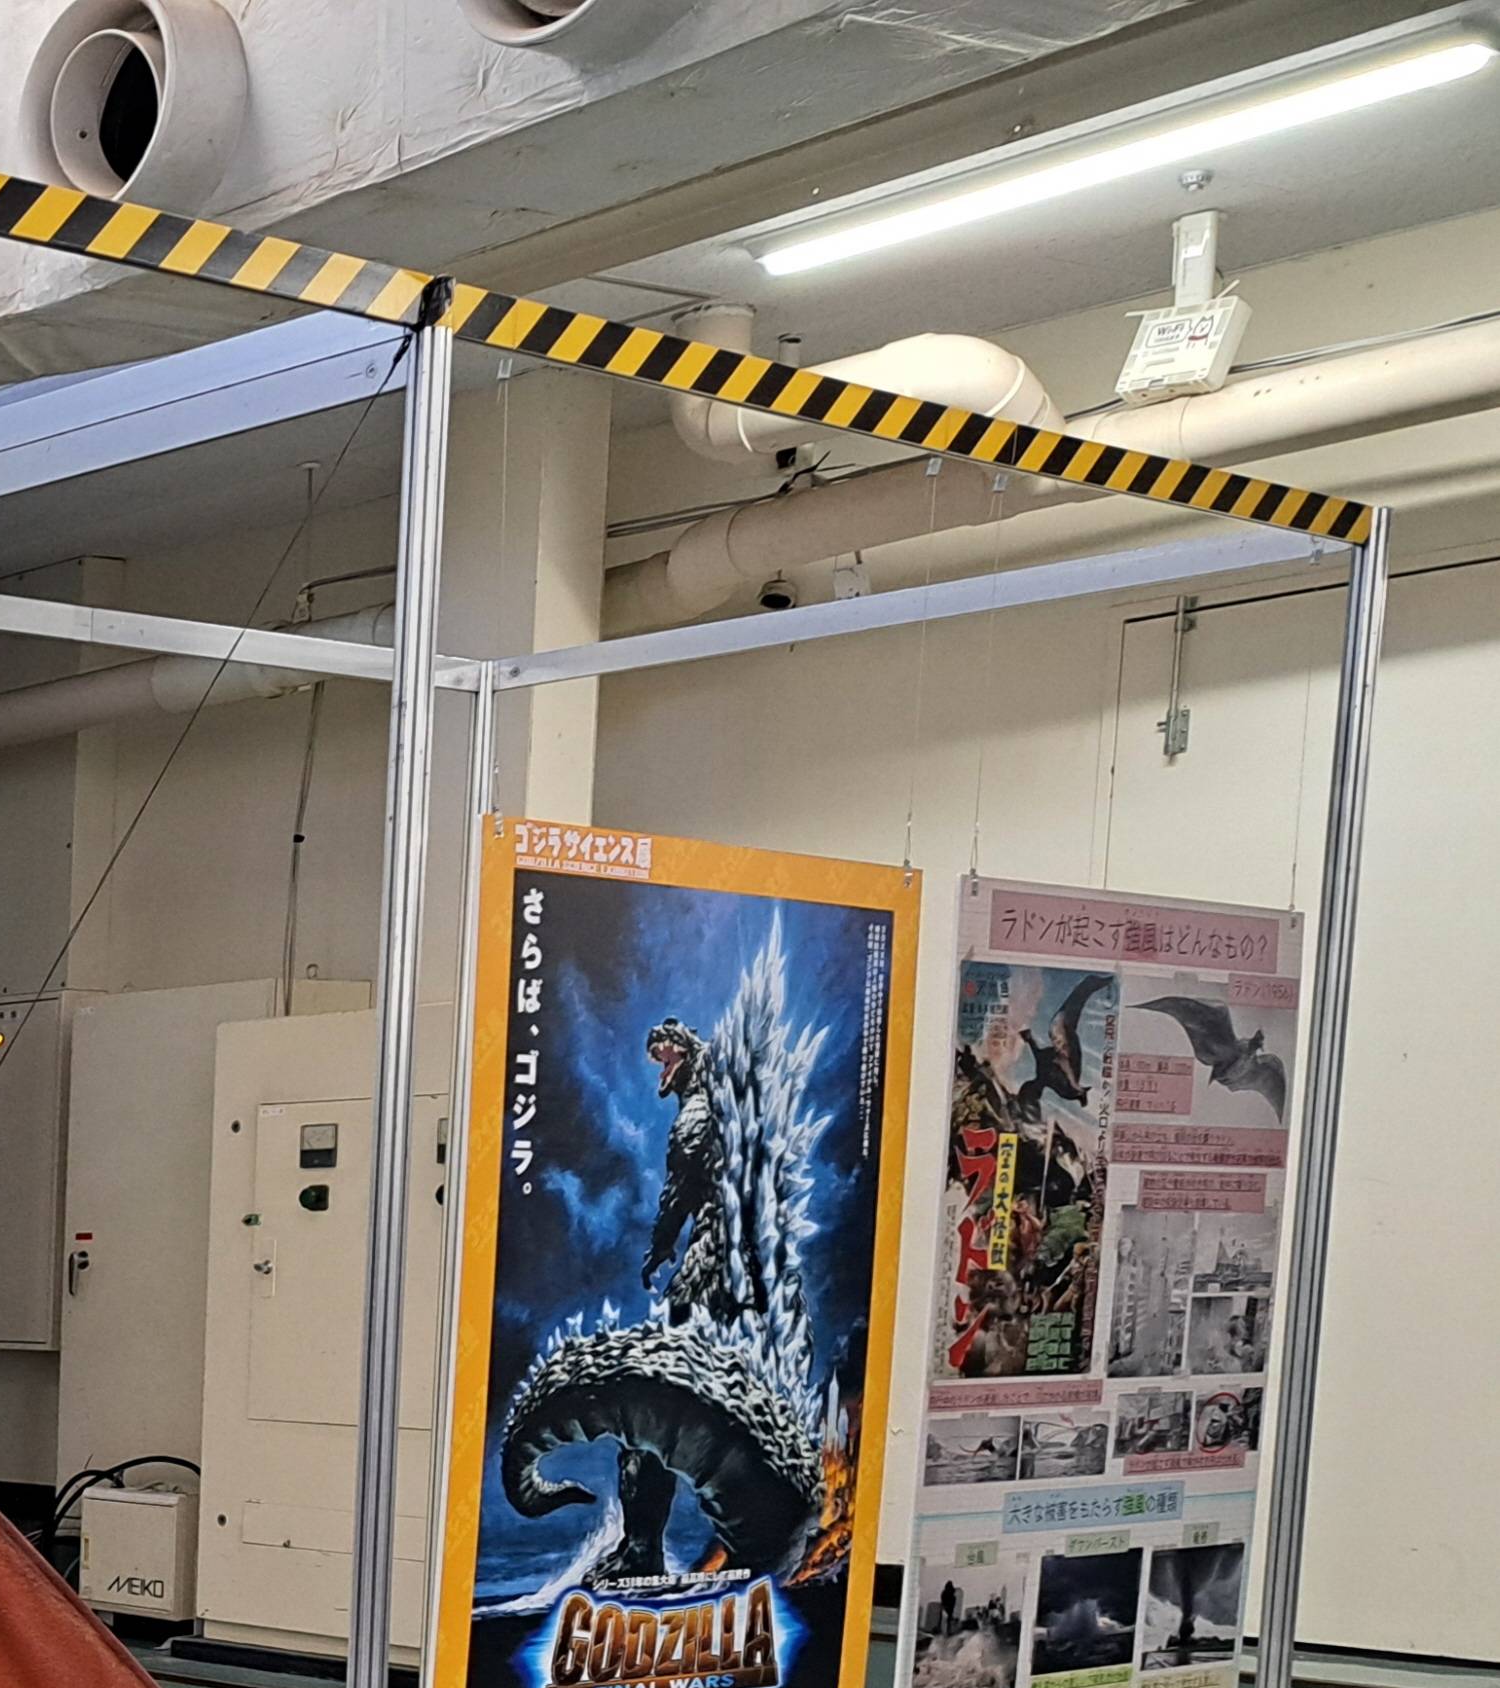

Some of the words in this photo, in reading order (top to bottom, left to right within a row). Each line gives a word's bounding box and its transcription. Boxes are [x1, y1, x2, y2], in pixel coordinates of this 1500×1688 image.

[515, 820, 653, 869] ゴジラサイエンス展
[509, 887, 545, 1196] さらば、ゴジラ。
[551, 1580, 776, 1688] GODZILLA
